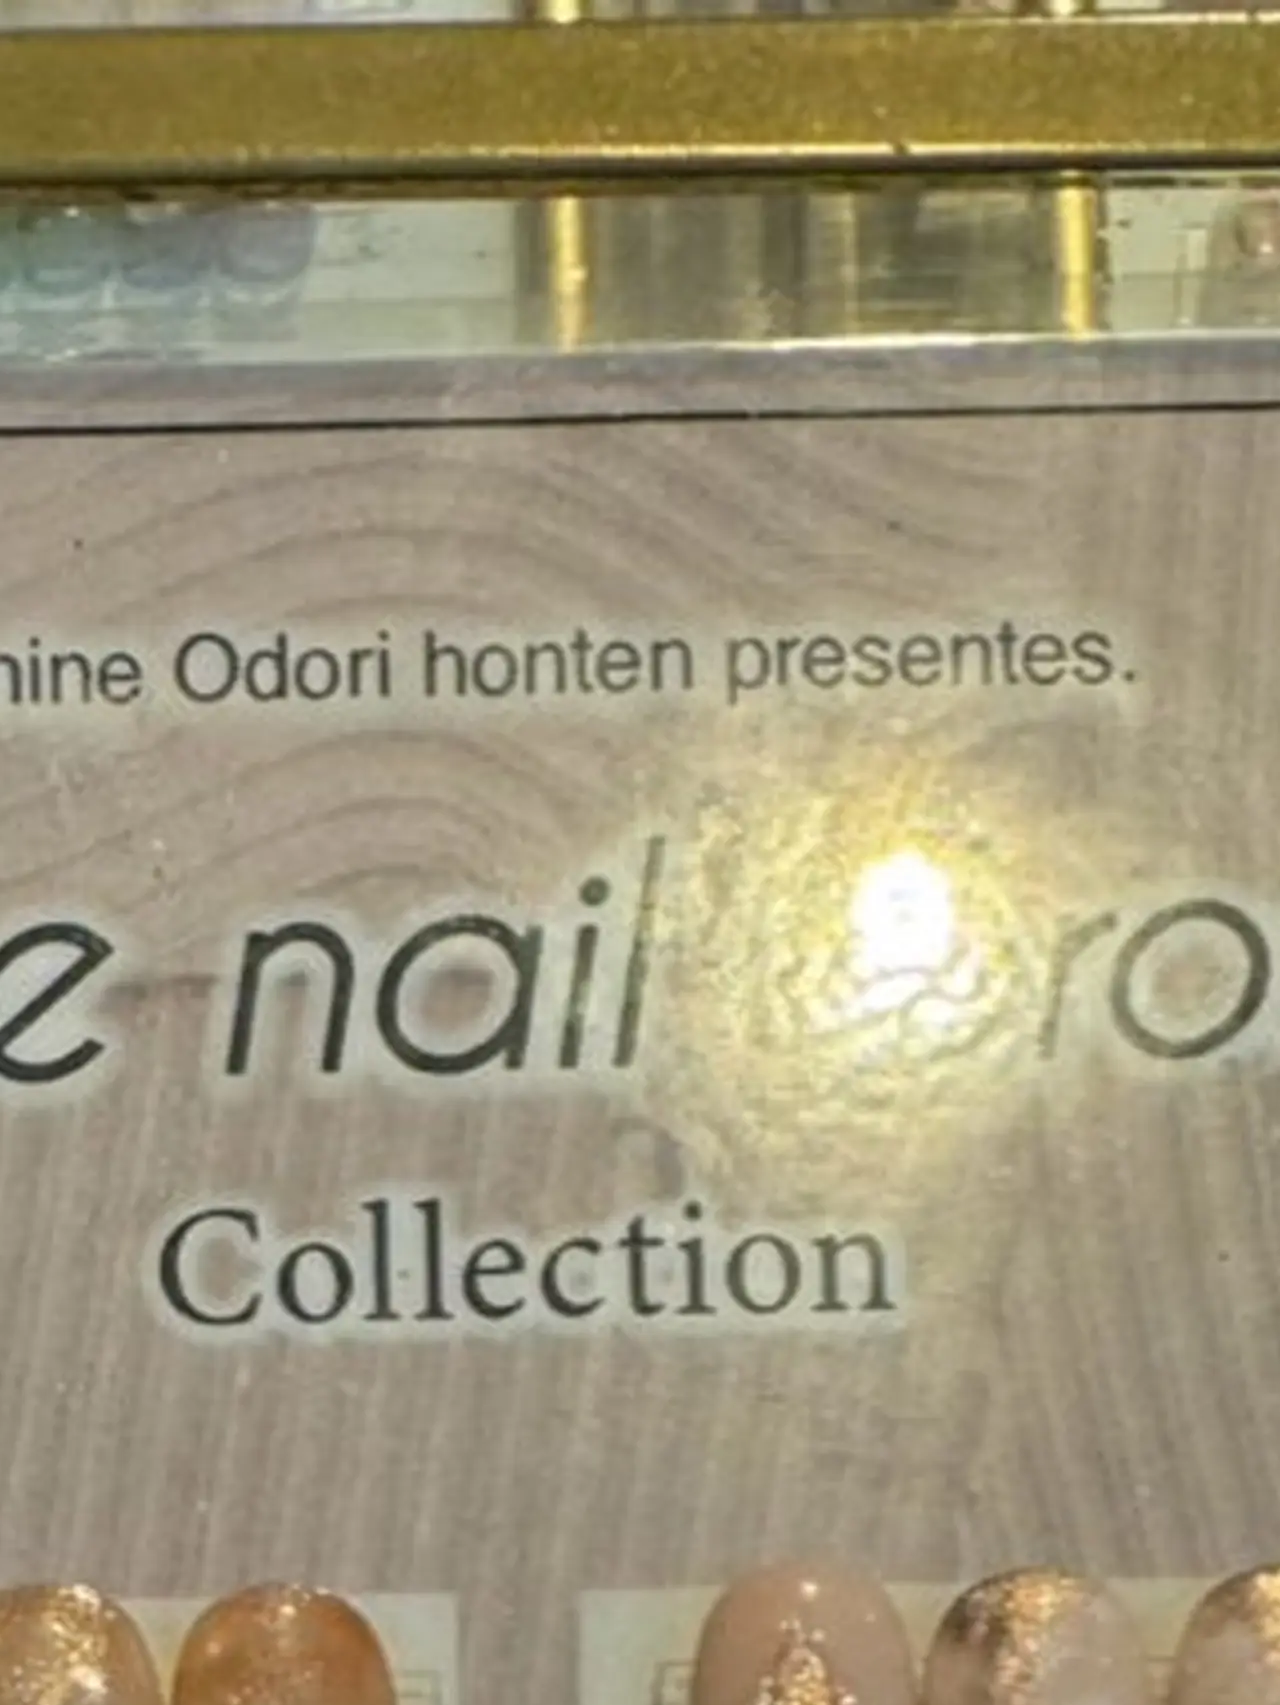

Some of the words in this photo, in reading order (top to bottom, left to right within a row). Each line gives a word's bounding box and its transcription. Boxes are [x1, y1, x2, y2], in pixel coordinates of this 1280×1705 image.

[172, 630, 394, 704] Odori
[422, 628, 696, 698] honten
[724, 618, 1140, 706] presentes.
[224, 834, 668, 1076] nail
[158, 1197, 898, 1327] Collection
